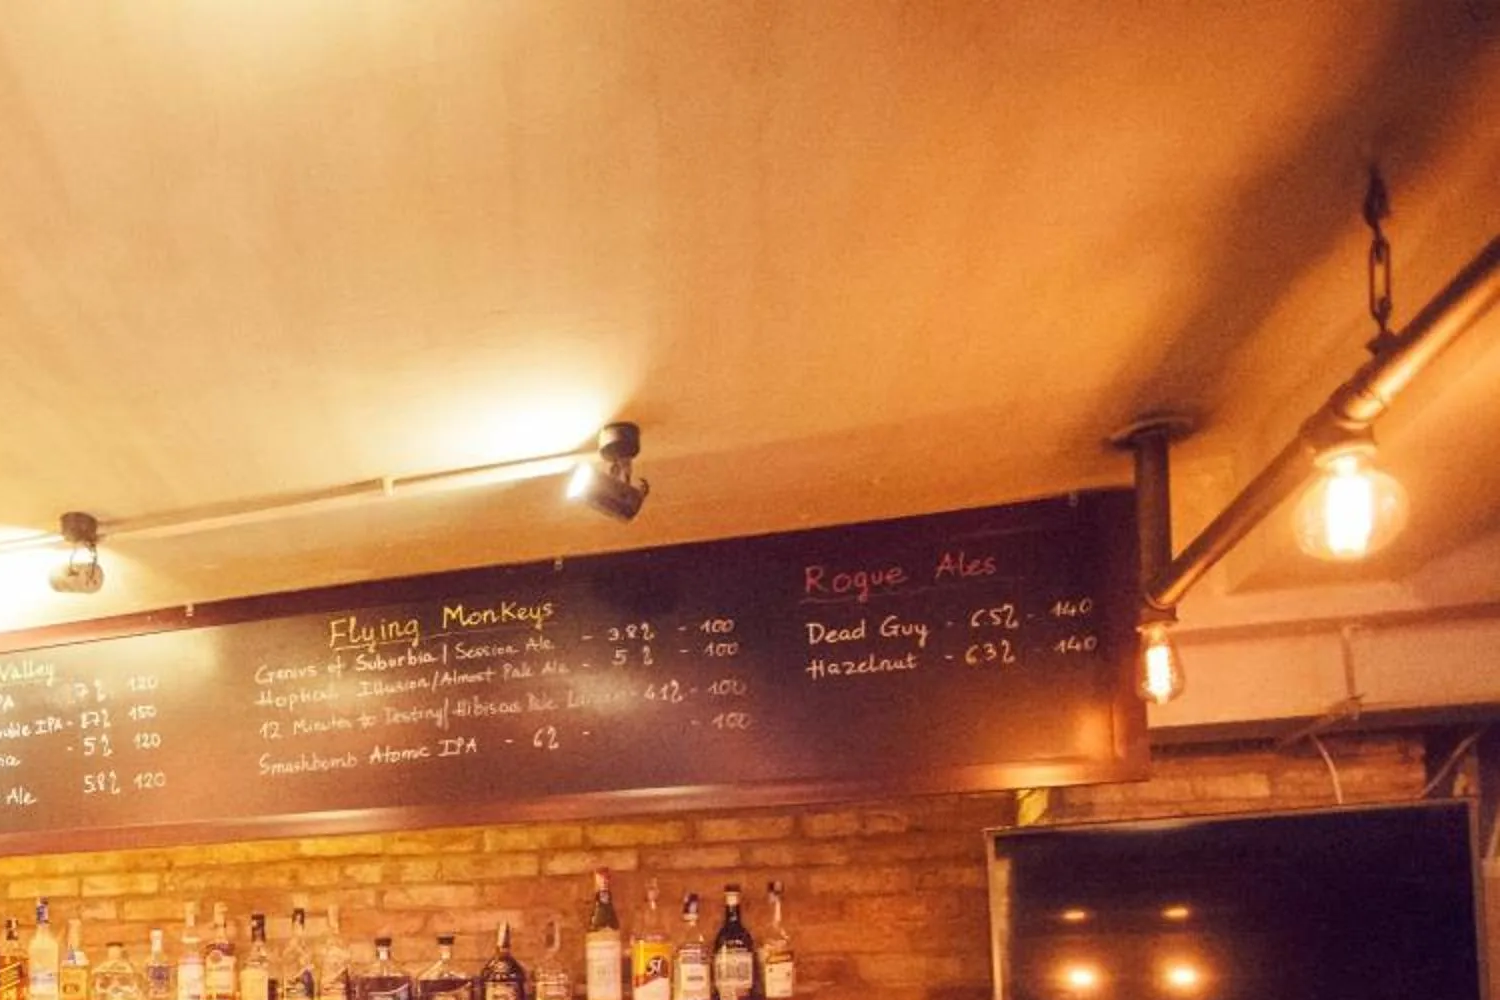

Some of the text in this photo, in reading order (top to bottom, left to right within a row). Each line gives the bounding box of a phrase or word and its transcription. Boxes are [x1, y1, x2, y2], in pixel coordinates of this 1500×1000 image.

[804, 552, 997, 601] Rogue Ales
[329, 617, 419, 653] Flying
[807, 622, 866, 645] Dead
[878, 616, 930, 647] Guy
[1050, 598, 1093, 617] 140
[254, 665, 318, 685] Genius
[355, 648, 438, 672] Suburbia
[700, 619, 735, 634] 100
[704, 643, 739, 657] 100
[806, 652, 920, 680] Hazelnut
[1054, 635, 1098, 654] 140
[133, 731, 163, 749] 120
[260, 722, 283, 742] 12
[438, 738, 477, 757] IPA
[4, 786, 39, 806] Ale
[133, 770, 168, 790] 120
